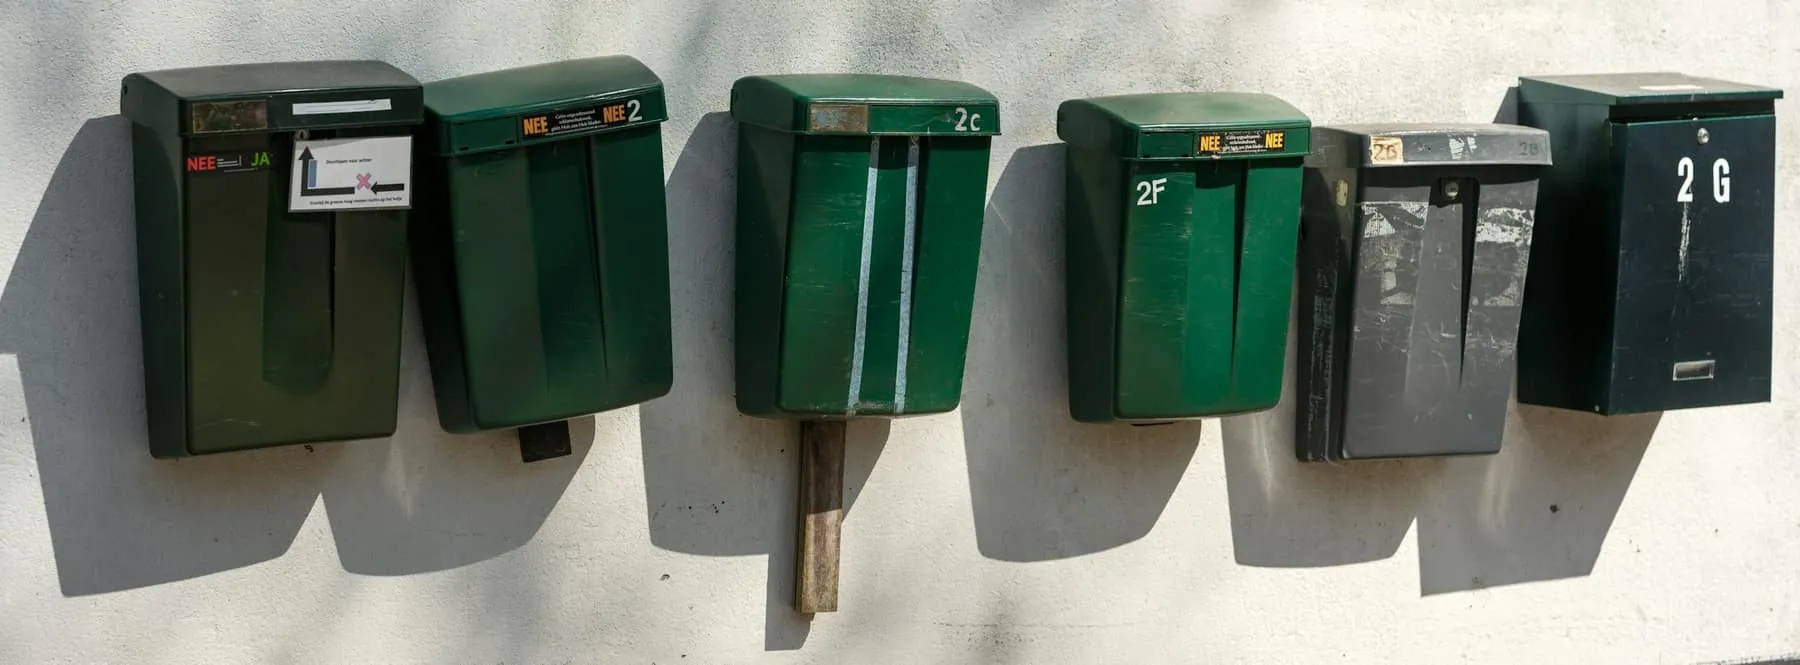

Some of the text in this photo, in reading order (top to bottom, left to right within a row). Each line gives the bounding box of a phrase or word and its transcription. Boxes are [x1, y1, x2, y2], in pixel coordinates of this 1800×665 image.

[523, 116, 548, 135] NEE
[603, 104, 625, 123] NEE
[627, 99, 643, 122] 2
[1200, 135, 1221, 152] NEE
[1265, 132, 1284, 149] NEE
[187, 156, 216, 171] NEE
[251, 152, 270, 167] JA
[1136, 178, 1167, 206] 2F
[1677, 156, 1731, 204] 2 G
